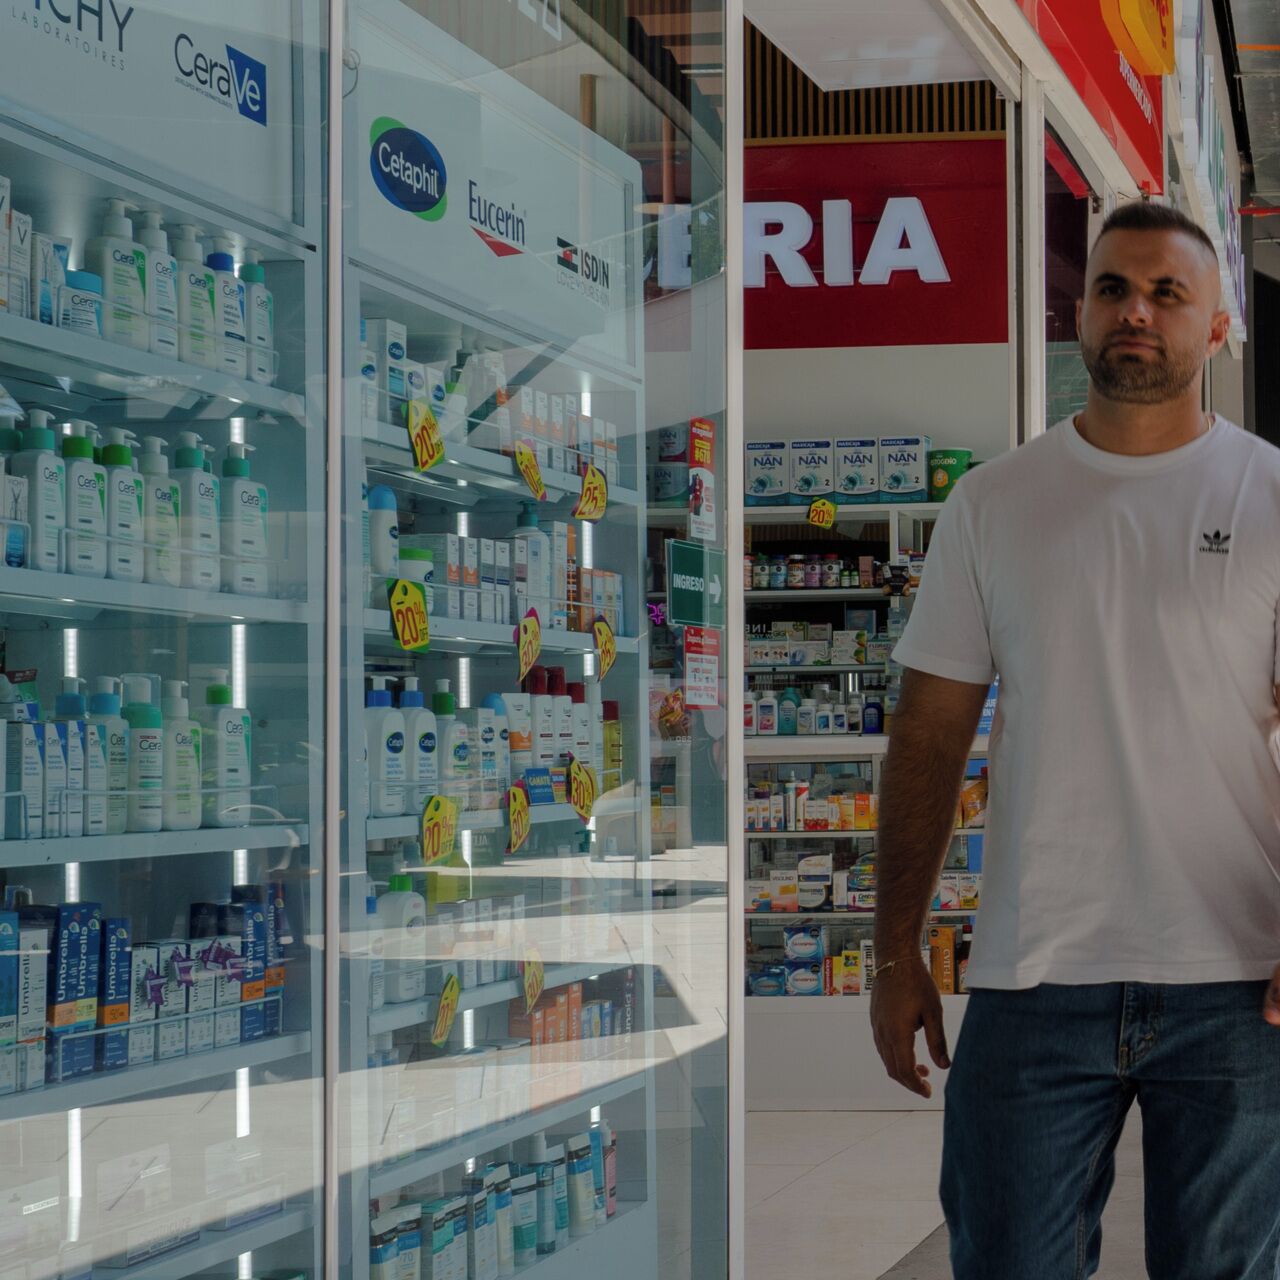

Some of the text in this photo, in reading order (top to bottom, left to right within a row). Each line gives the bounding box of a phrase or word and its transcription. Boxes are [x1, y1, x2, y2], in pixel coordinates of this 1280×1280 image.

[11, 6, 126, 71] LABORATOIRES
[173, 32, 262, 112] CeraVe
[1119, 51, 1153, 125] SUPERMERCADO
[378, 141, 440, 200] Cetaphil
[469, 179, 526, 247] Eucerin
[580, 248, 610, 290] ISDIN
[753, 456, 783, 467] NAN
[798, 455, 828, 466] NAN
[843, 453, 873, 464] NAN
[888, 452, 917, 463] NAN
[823, 478, 831, 487] 2
[869, 477, 877, 486] 2
[913, 476, 921, 484] 2
[811, 506, 834, 525] 20%
[673, 572, 705, 592] INGRESO
[395, 600, 426, 647] 20%
[57, 928, 69, 1002] Umbrella
[77, 925, 88, 998] Umbrella
[107, 934, 118, 1000] Umbrella
[247, 918, 255, 979] Umbrella
